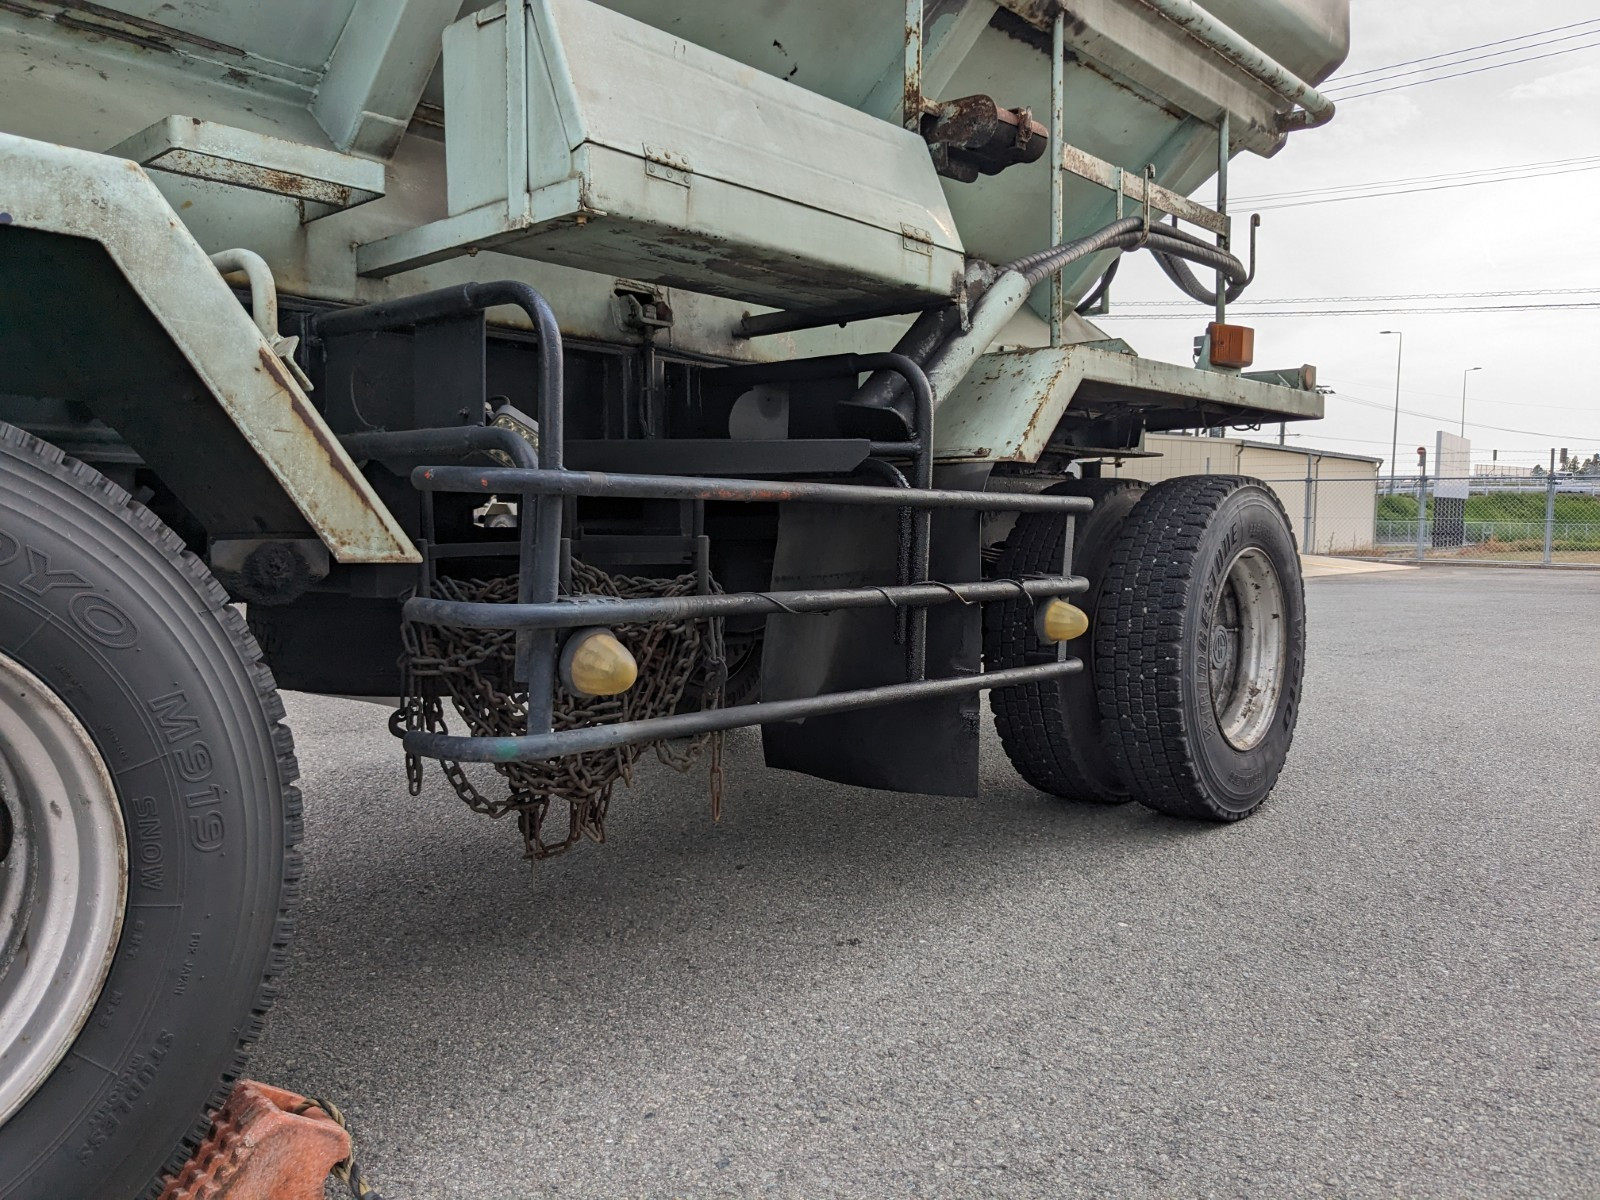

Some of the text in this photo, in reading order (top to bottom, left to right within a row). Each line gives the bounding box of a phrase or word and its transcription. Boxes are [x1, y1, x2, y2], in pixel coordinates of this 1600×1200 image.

[147, 689, 226, 852] M919
[131, 795, 165, 892] SNOW
[173, 960, 195, 996] JAPAN
[77, 1028, 175, 1168] STUDLESS
